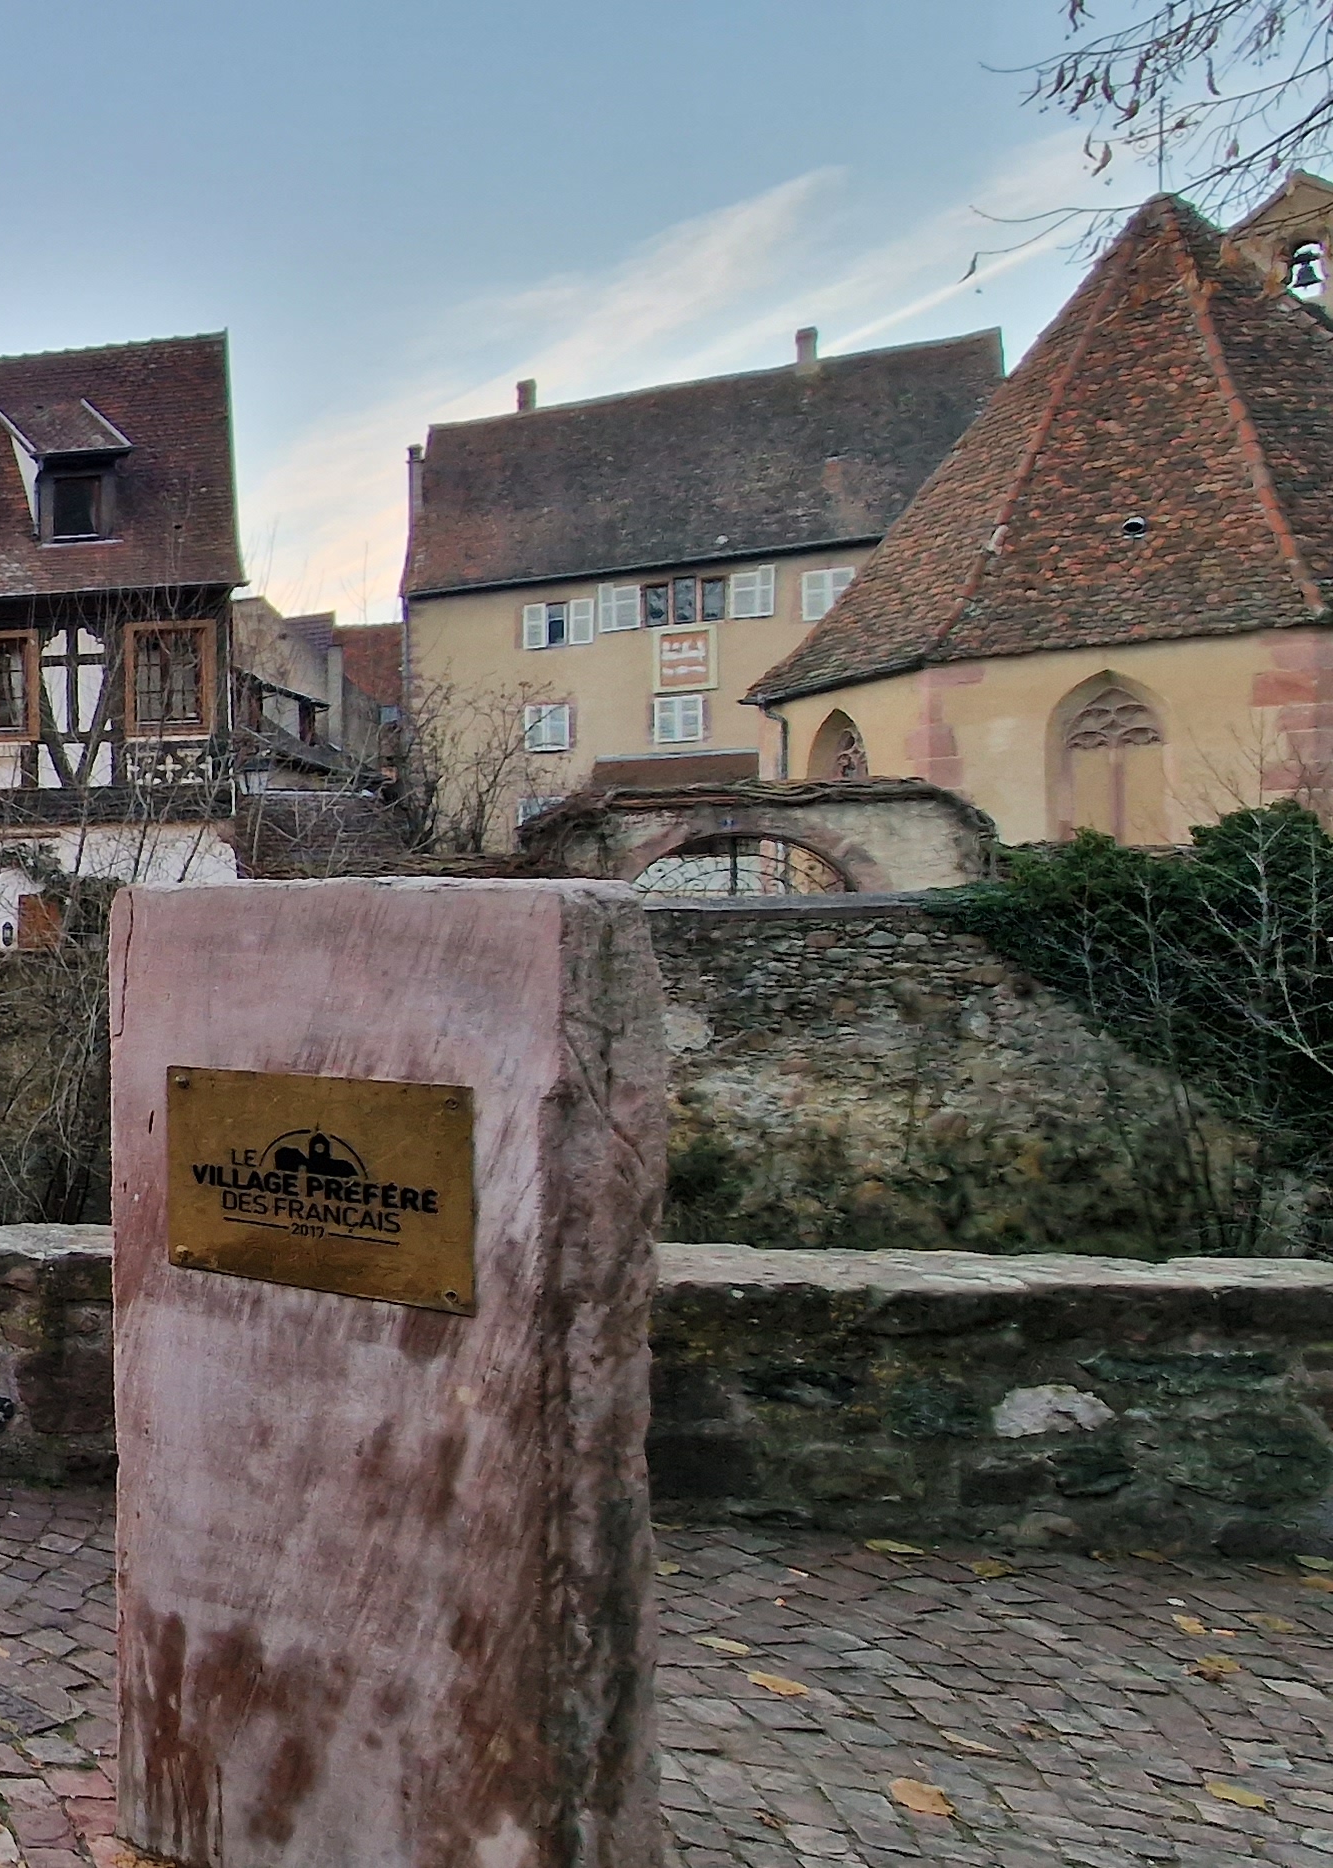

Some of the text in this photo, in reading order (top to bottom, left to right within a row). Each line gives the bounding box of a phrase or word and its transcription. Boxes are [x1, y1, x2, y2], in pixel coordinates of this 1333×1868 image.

[231, 1148, 257, 1167] LE
[193, 1164, 300, 1197] VILLAGE
[222, 1191, 401, 1233] DES FRANÇAIS
[291, 1222, 325, 1238] 2017
